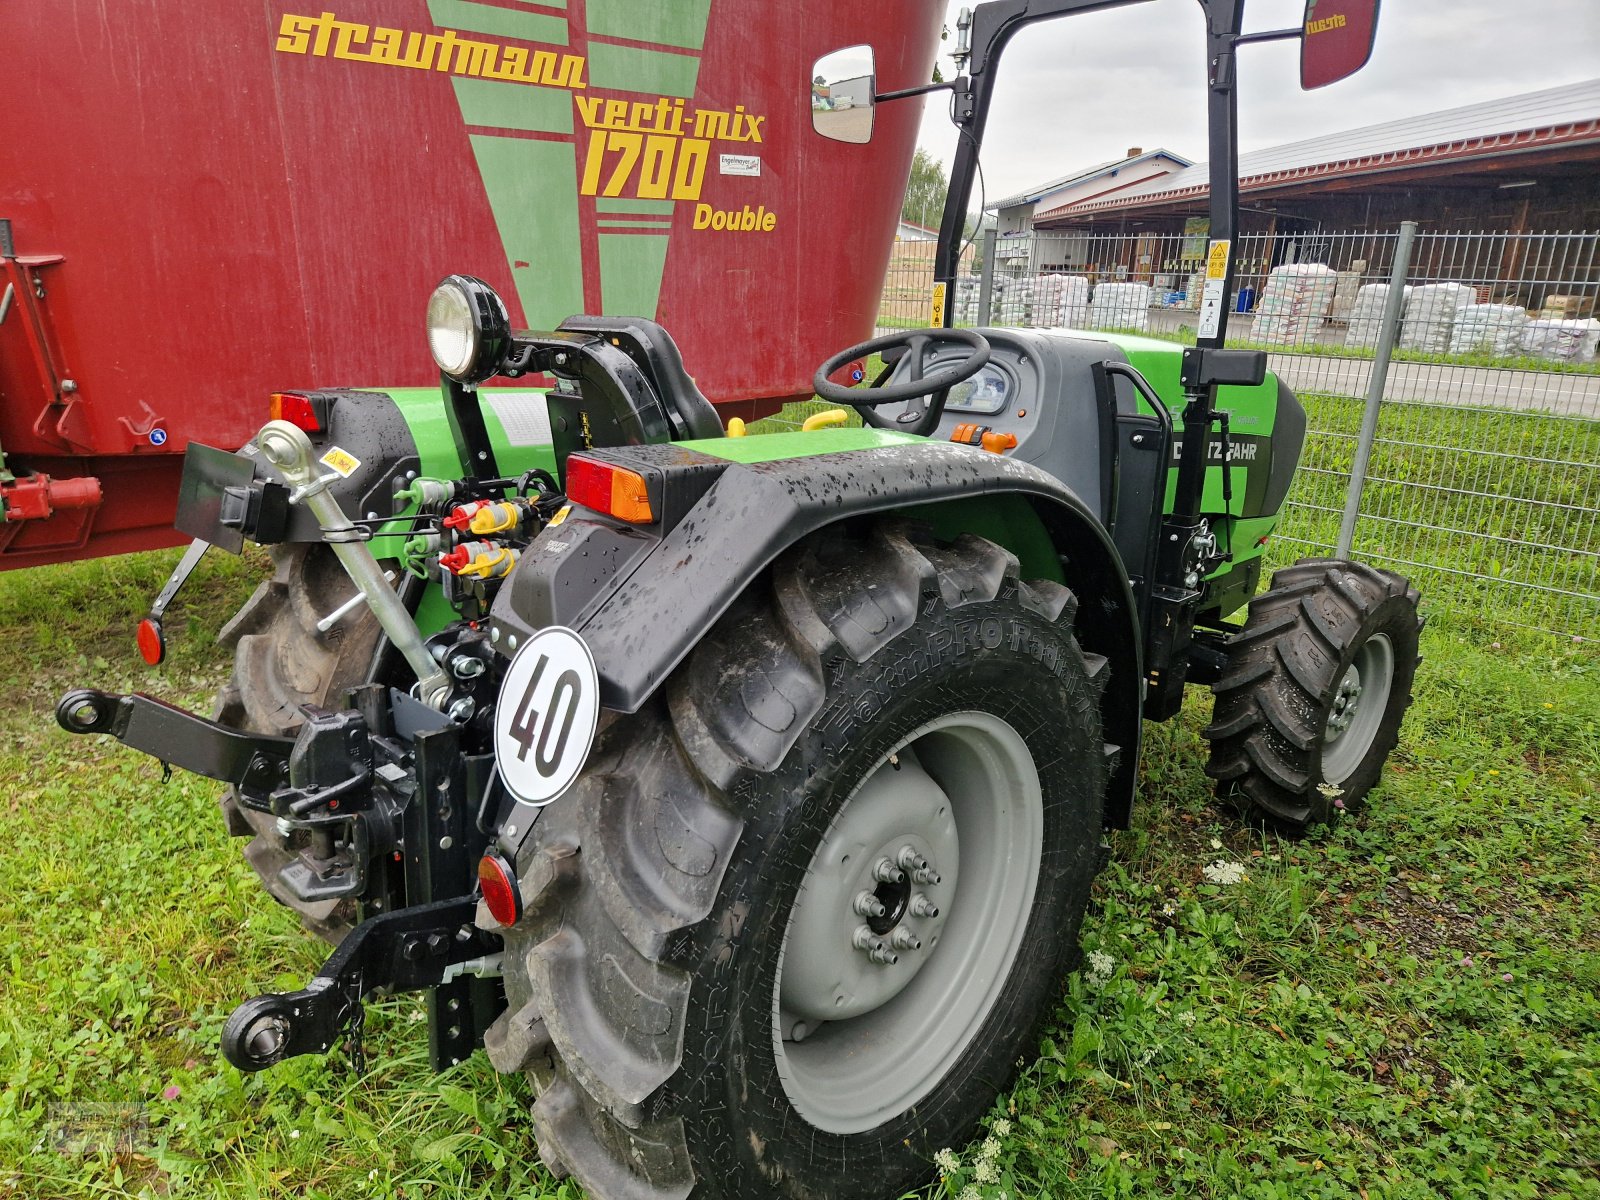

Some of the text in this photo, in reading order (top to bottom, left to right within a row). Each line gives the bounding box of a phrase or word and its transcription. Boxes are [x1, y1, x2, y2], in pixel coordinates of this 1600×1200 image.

[275, 12, 587, 89] strautmann
[575, 96, 765, 143] verti-mix
[580, 130, 711, 200] 1700
[693, 203, 777, 232] Double
[508, 653, 582, 778] 40
